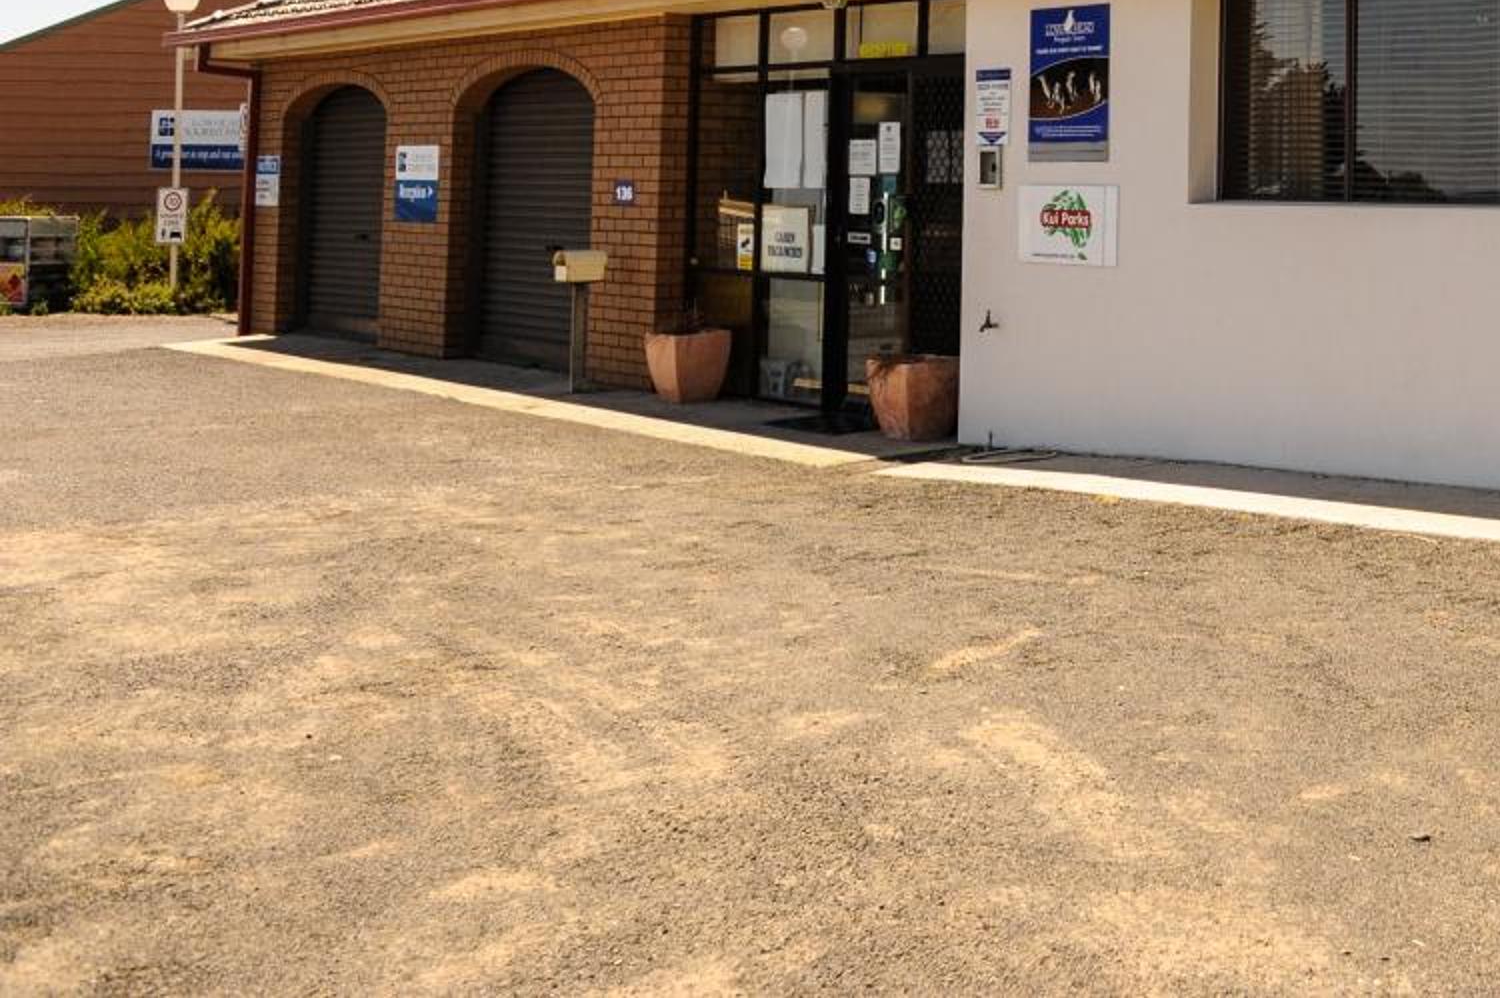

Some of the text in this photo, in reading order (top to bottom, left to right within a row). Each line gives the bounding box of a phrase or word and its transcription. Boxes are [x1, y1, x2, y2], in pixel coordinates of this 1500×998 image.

[616, 185, 633, 200] 136
[1042, 211, 1089, 226] Kui Parks
